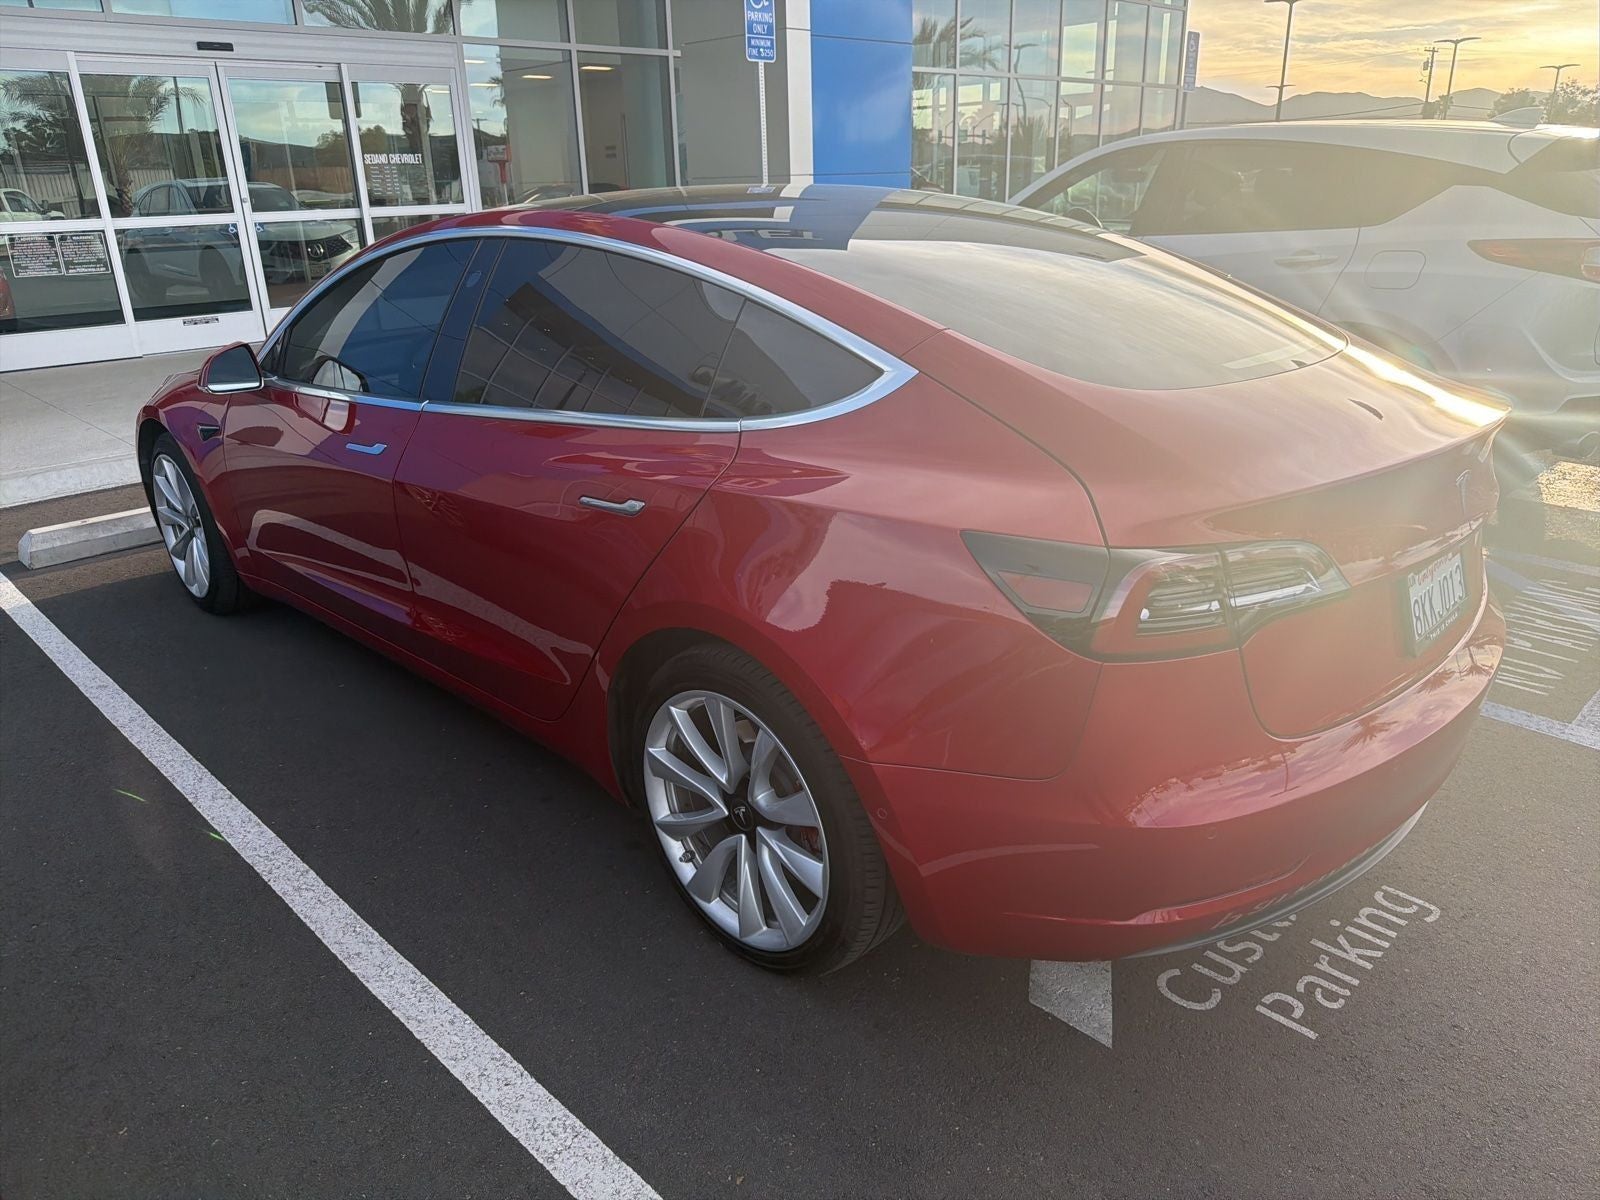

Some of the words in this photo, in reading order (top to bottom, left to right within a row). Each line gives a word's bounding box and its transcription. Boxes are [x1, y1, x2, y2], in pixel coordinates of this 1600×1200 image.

[747, 10, 773, 23] PARKING
[752, 23, 768, 34] ONLY
[750, 38, 771, 47] MINIMUM
[748, 47, 759, 56] FINE
[364, 153, 388, 164] SEDANO
[388, 153, 422, 164] CHEVROLET
[1413, 564, 1465, 635] 8KKJ013
[1255, 885, 1441, 1040] Parking
